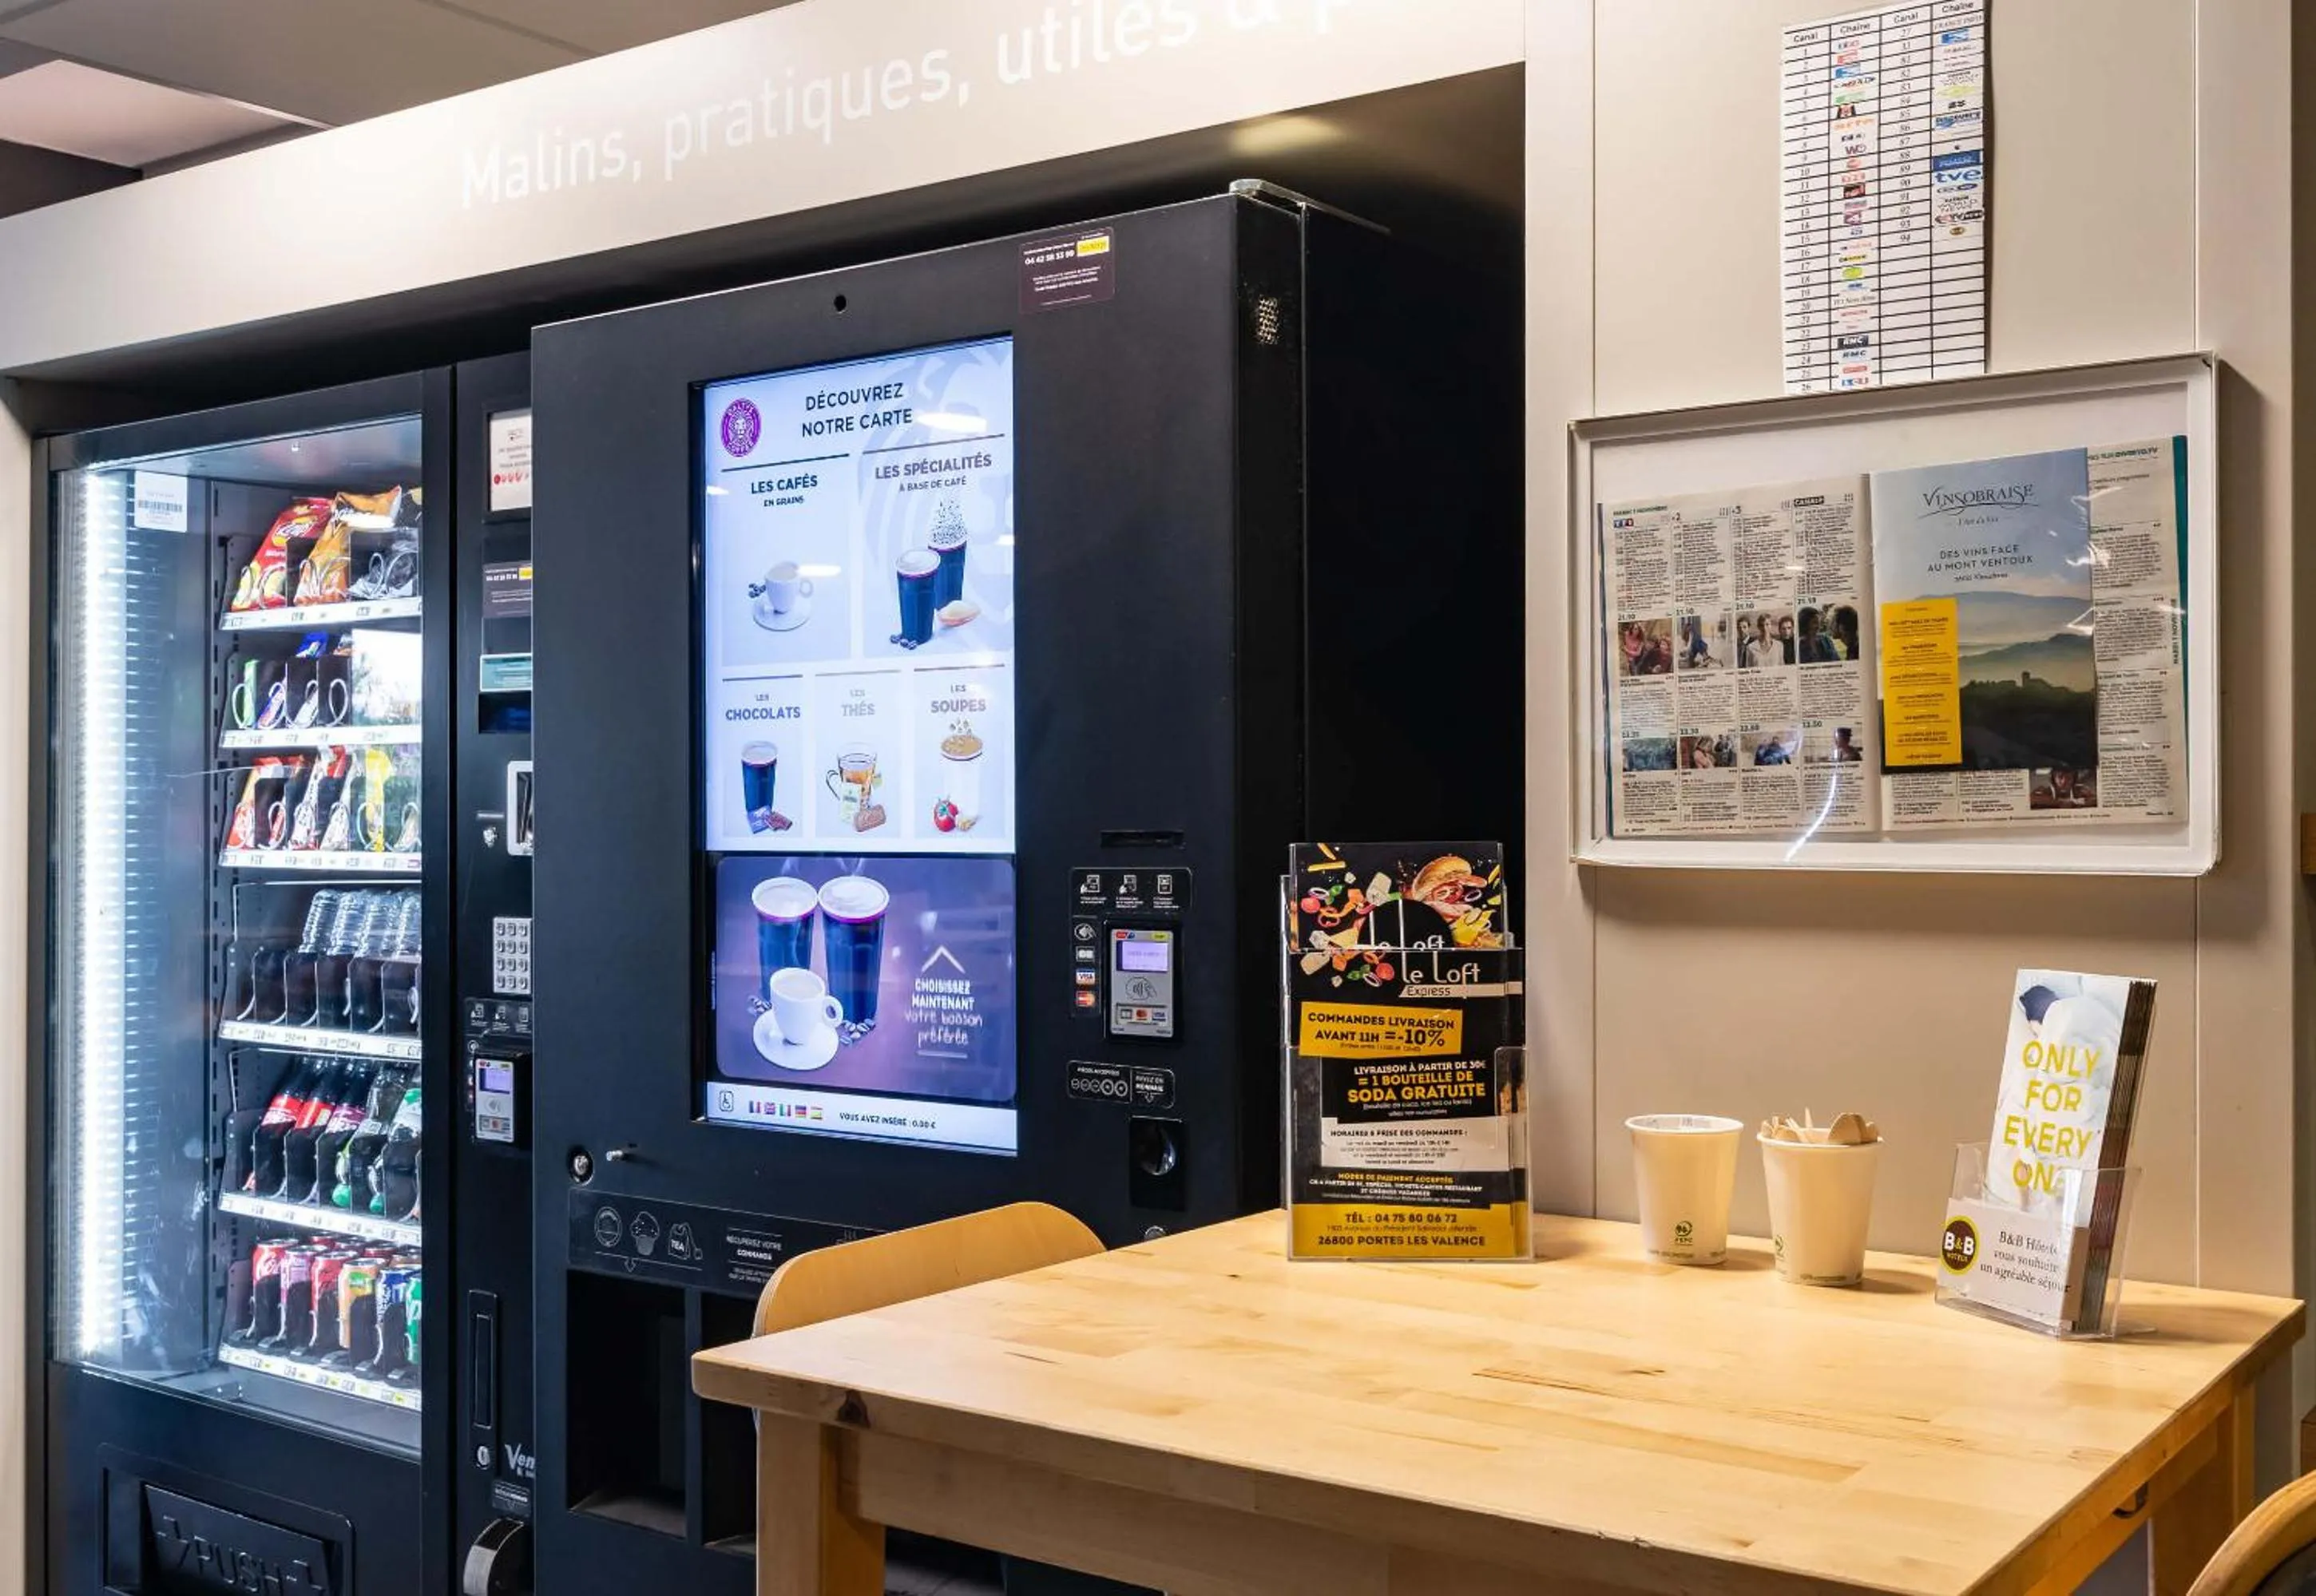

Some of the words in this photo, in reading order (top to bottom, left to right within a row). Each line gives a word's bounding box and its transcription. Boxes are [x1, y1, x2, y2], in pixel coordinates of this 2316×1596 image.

[1794, 32, 1818, 42] Canal
[1894, 12, 1918, 23] Canal
[461, 127, 641, 208] Malins,
[664, 48, 970, 180] pratiques,
[805, 382, 904, 411] DÉCOUVREZ
[802, 418, 855, 438] NOTRE
[859, 408, 913, 430] CARTE
[875, 464, 901, 480] LES
[903, 451, 993, 477] SPÉCIALITÉS
[751, 479, 773, 495] LES
[776, 473, 819, 493] CAFÉS
[907, 481, 929, 492] BASE
[930, 479, 942, 489] DE
[944, 476, 967, 488] CAFÉ
[763, 498, 775, 508] EN
[775, 494, 804, 506] GRAINS
[1923, 483, 2035, 506] VINSOBRAISE
[1939, 549, 1960, 560] DES
[1963, 547, 1988, 556] VINS
[1991, 544, 2021, 554] FACE
[1927, 563, 1941, 572] AU
[1945, 560, 1977, 570] MONT
[1980, 555, 2033, 568] VENTOUX
[950, 685, 966, 694] LES
[725, 706, 800, 721] CHOCOLATS
[842, 700, 875, 717] THÉS
[930, 699, 987, 715] SOUPES
[1433, 951, 1481, 985] Loft
[915, 978, 970, 995] CHOISISSEZ
[1407, 986, 1451, 996] Express
[912, 994, 975, 1011] MAINTENANT
[1308, 1012, 1386, 1026] COMMANDES
[1388, 1016, 1454, 1029] LIVRAISON
[1315, 1030, 1355, 1041] AVANT
[1359, 1032, 1379, 1043] 11H
[1354, 1064, 1406, 1075] LIVRAISON
[1409, 1062, 1417, 1072] À
[1418, 1062, 1453, 1071] PARTIR
[1454, 1060, 1467, 1070] DE
[2022, 1040, 2102, 1079] ONLY
[1372, 1076, 1380, 1087] 1
[1382, 1071, 1453, 1086] BOUTEILLE
[1456, 1070, 1473, 1082] DE
[1347, 1086, 1398, 1103] SODA
[1401, 1083, 1486, 1100] GRATUITE
[2025, 1080, 2081, 1112] FOR
[839, 1112, 859, 1122] VOUS
[861, 1115, 878, 1124] AVEZ
[2003, 1115, 2093, 1158] EVERY
[1377, 1174, 1414, 1183] PAIEMENT
[1346, 1212, 1363, 1223] TÉL
[1375, 1214, 1389, 1223] 04
[1392, 1214, 1406, 1223] 75
[1426, 1214, 1441, 1223] 06
[1444, 1214, 1457, 1223] 72
[671, 1238, 685, 1252] TEA
[1319, 1236, 1354, 1246] 26800
[1358, 1236, 1404, 1246] PORTES
[1407, 1236, 1428, 1246] LES
[1432, 1236, 1485, 1246] VALENCE
[1945, 1232, 1974, 1256] B&B
[1999, 1230, 2024, 1247] B&B
[1981, 1264, 1993, 1273] un
